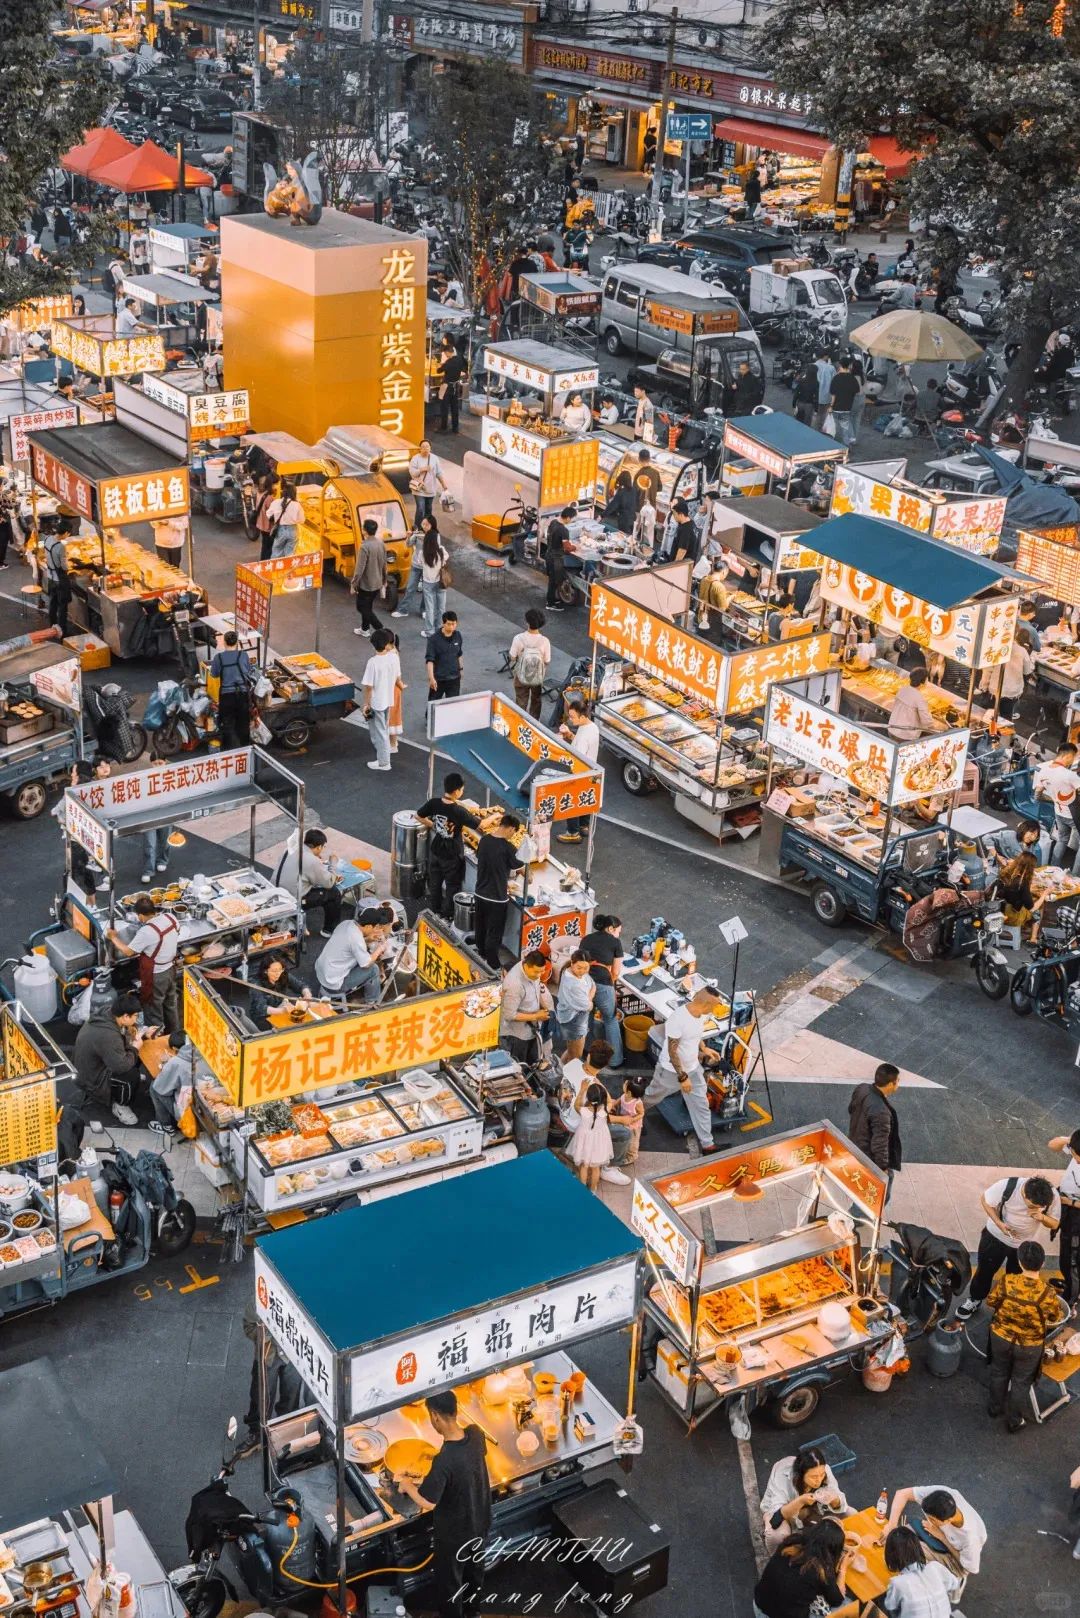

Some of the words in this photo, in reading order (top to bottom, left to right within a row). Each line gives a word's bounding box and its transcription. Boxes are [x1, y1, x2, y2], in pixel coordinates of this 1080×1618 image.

[12, 408, 76, 429] 芽菜碎肉炒饭
[194, 391, 246, 412] 臭豆腐
[194, 408, 247, 425] 烤冷面
[104, 475, 187, 519] 铁板鱿鱼
[846, 477, 922, 529] 水果捞
[938, 502, 1004, 531] 水果捞
[593, 592, 653, 656] 老二炸串
[655, 628, 718, 690] 铁板鱿鱼
[737, 636, 820, 680] 老二炸串
[982, 605, 1002, 664] 串串香
[773, 697, 888, 773] 老北京爆肚
[111, 777, 141, 804] 馄饨
[147, 752, 248, 797] 正宗武汉热干面
[539, 788, 596, 818] 烤生蚝
[250, 1002, 467, 1099] 杨记麻辣烫
[694, 1144, 816, 1197] 久久鸭脖
[269, 1291, 330, 1396] 福鼎肉片
[437, 1293, 598, 1372] 福鼎肉片
[400, 1355, 414, 1381] 阿乐
